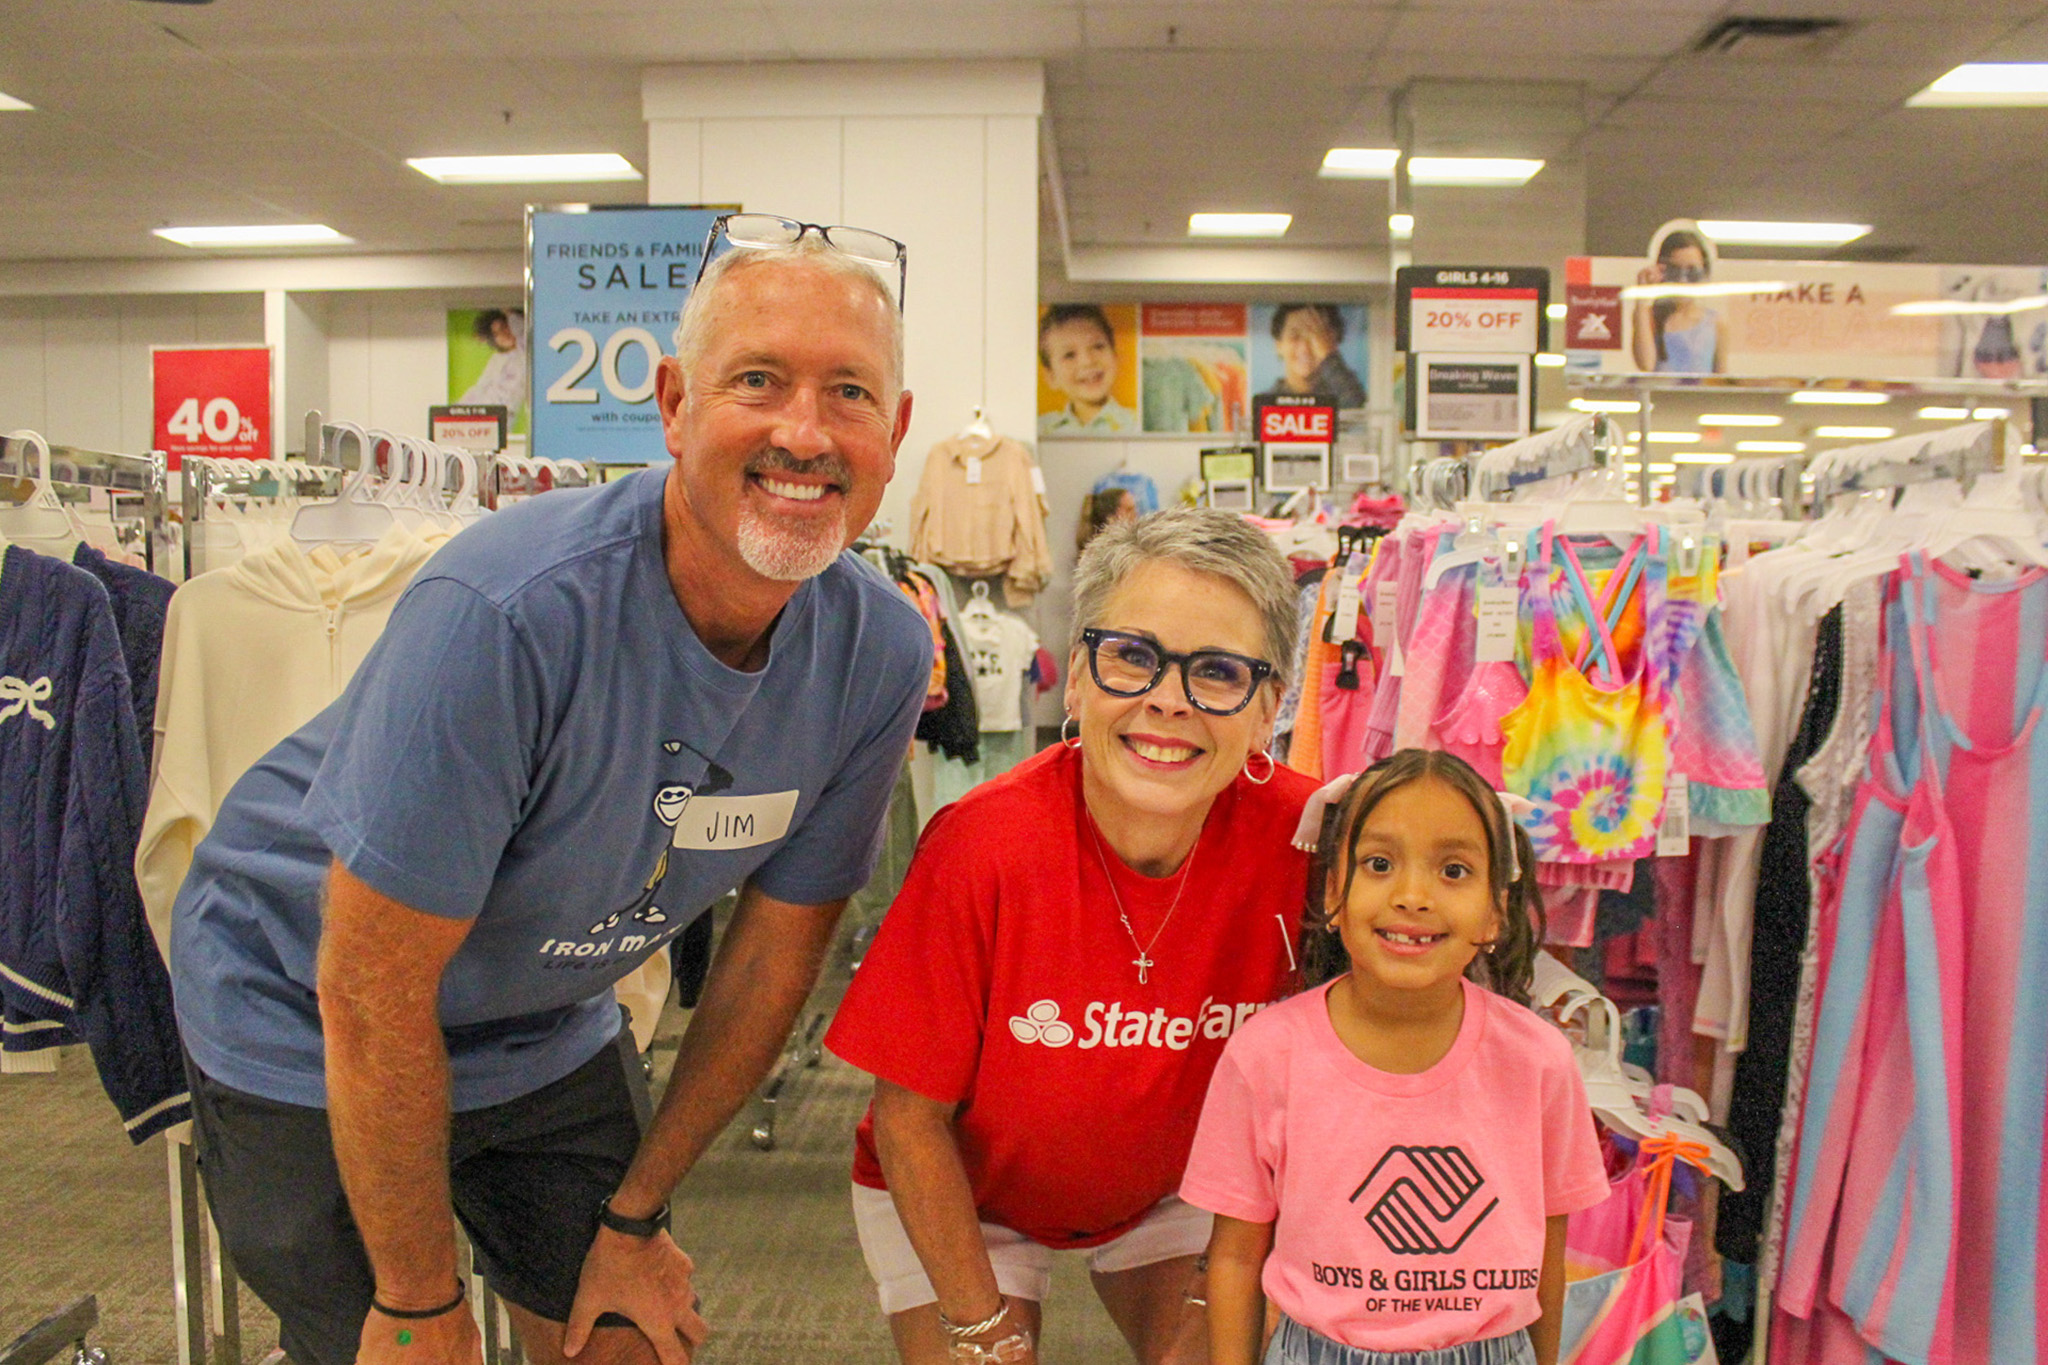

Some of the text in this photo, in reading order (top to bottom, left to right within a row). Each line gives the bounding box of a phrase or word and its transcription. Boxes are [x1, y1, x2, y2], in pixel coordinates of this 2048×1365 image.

[547, 242, 629, 259] FRIENDS
[636, 245, 645, 257] &
[578, 263, 688, 290] SALE
[1436, 271, 1509, 284] GIRLS 4-16
[1846, 283, 1866, 305] A
[574, 312, 681, 324] TAKE AN EXTR
[1426, 312, 1522, 328] 20% OFF
[591, 411, 660, 423] with coupo
[1264, 413, 1329, 436] SALE
[442, 428, 491, 438] 20% OFF
[707, 811, 753, 842] JIM
[539, 938, 614, 957] IRON
[1312, 1262, 1538, 1291] BOYS & GIRLS CLUBS
[1366, 1297, 1483, 1312] OF THE VALLEY
